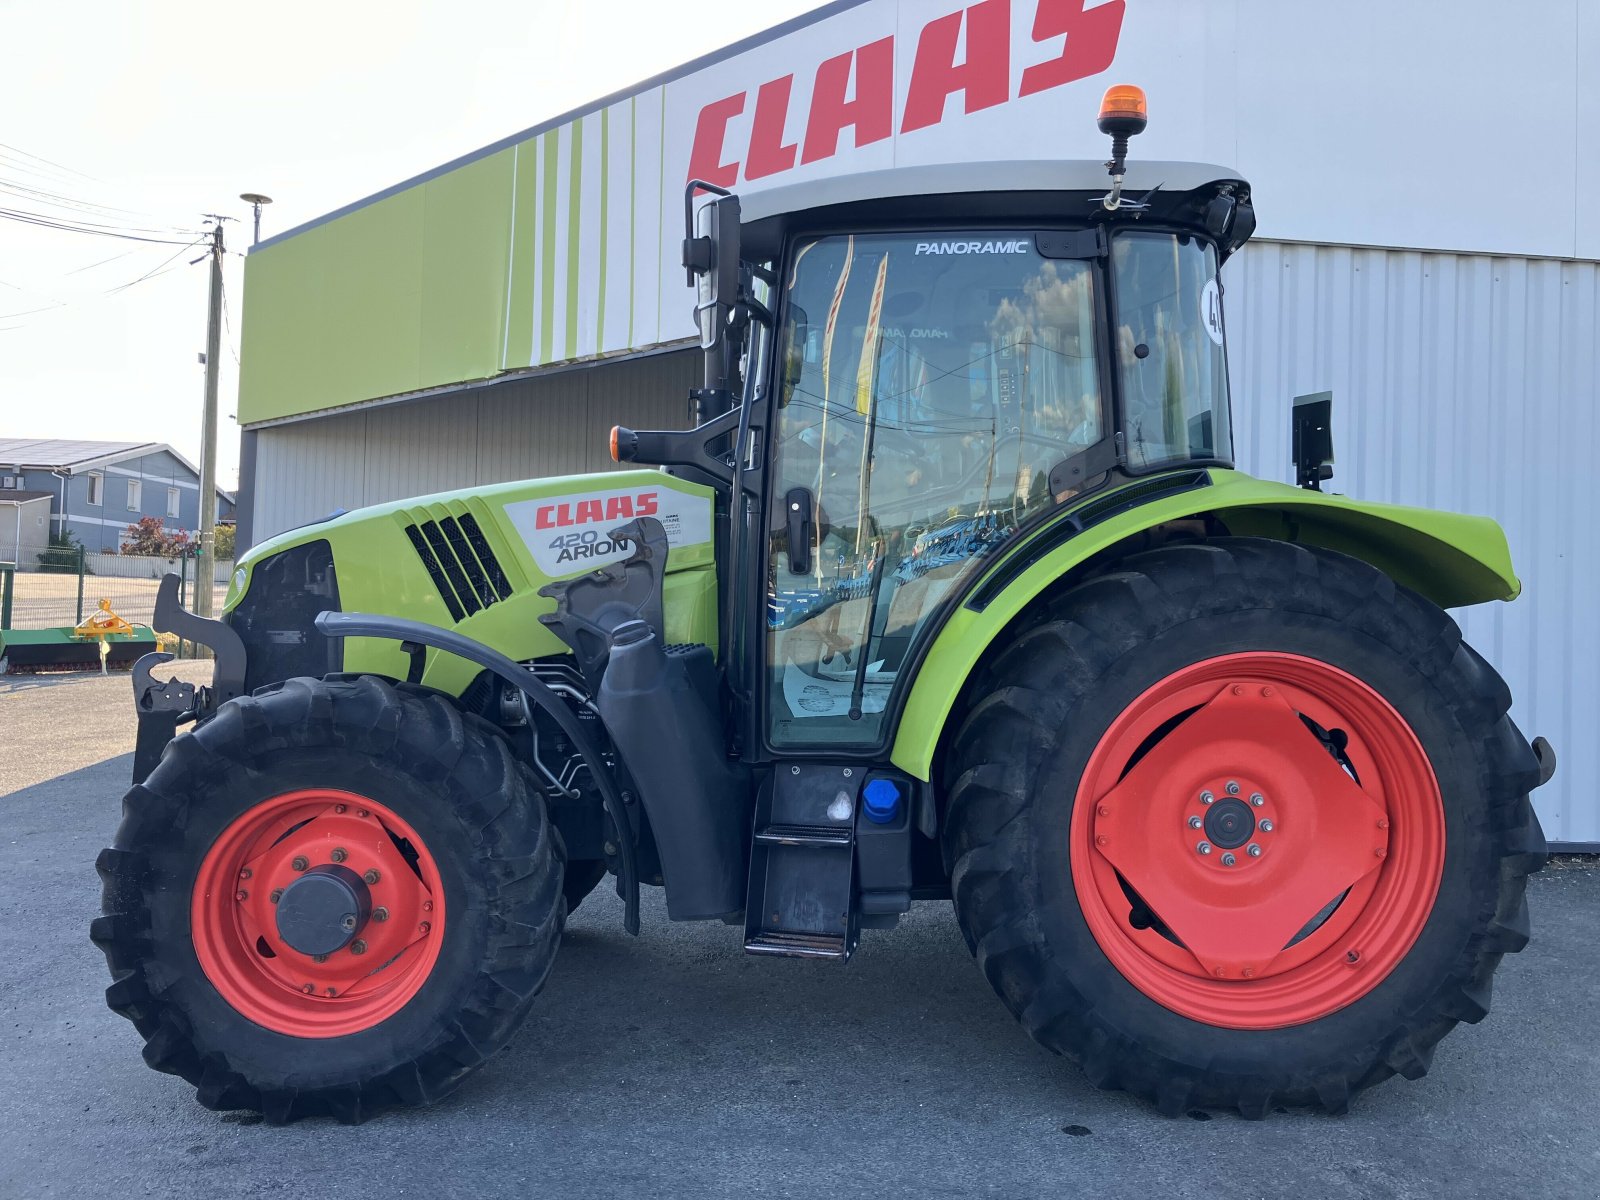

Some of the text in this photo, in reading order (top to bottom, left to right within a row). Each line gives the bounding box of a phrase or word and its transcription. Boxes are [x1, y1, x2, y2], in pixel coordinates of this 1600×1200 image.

[686, 0, 1126, 197] CLAAS
[914, 241, 1029, 255] PANORAMIC
[536, 493, 657, 529] CLAAS
[548, 530, 598, 550] 420
[556, 540, 628, 563] ARION
